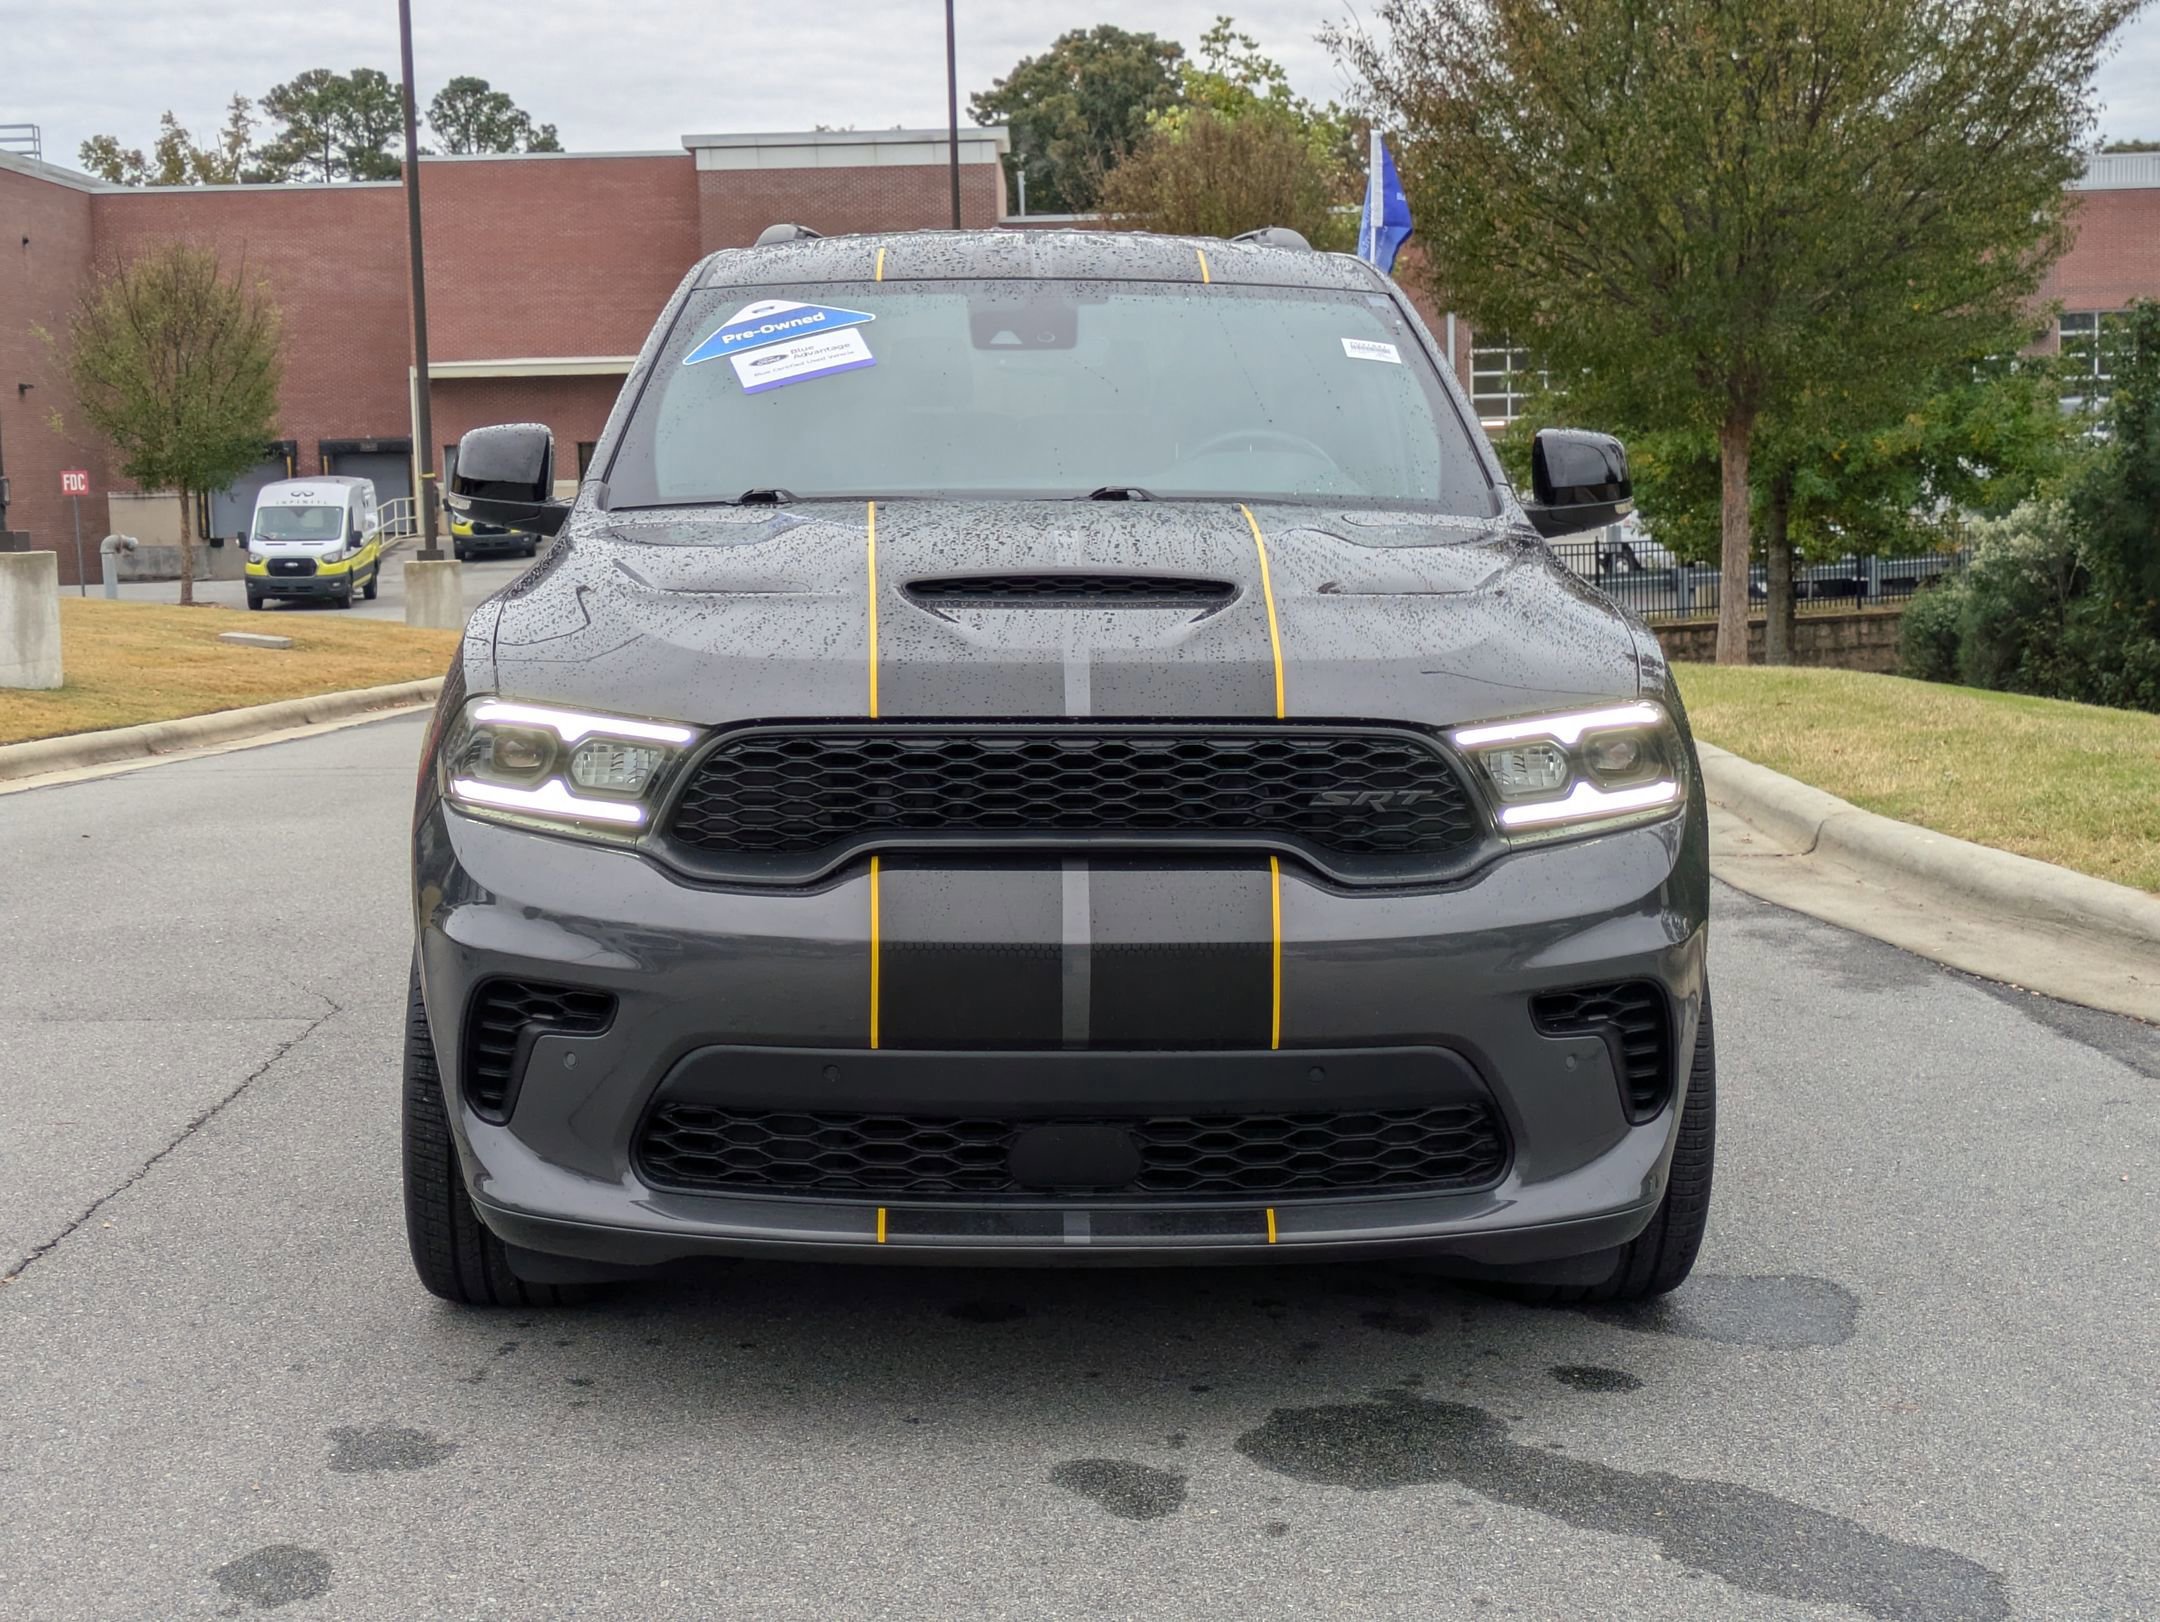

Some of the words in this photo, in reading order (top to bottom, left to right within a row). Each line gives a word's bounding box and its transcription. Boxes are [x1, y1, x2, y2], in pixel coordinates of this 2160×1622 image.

[721, 312, 826, 344] Pre-Owned
[793, 343, 851, 359] Advantage
[63, 473, 86, 491] FDC
[1309, 789, 1434, 813] SRT
